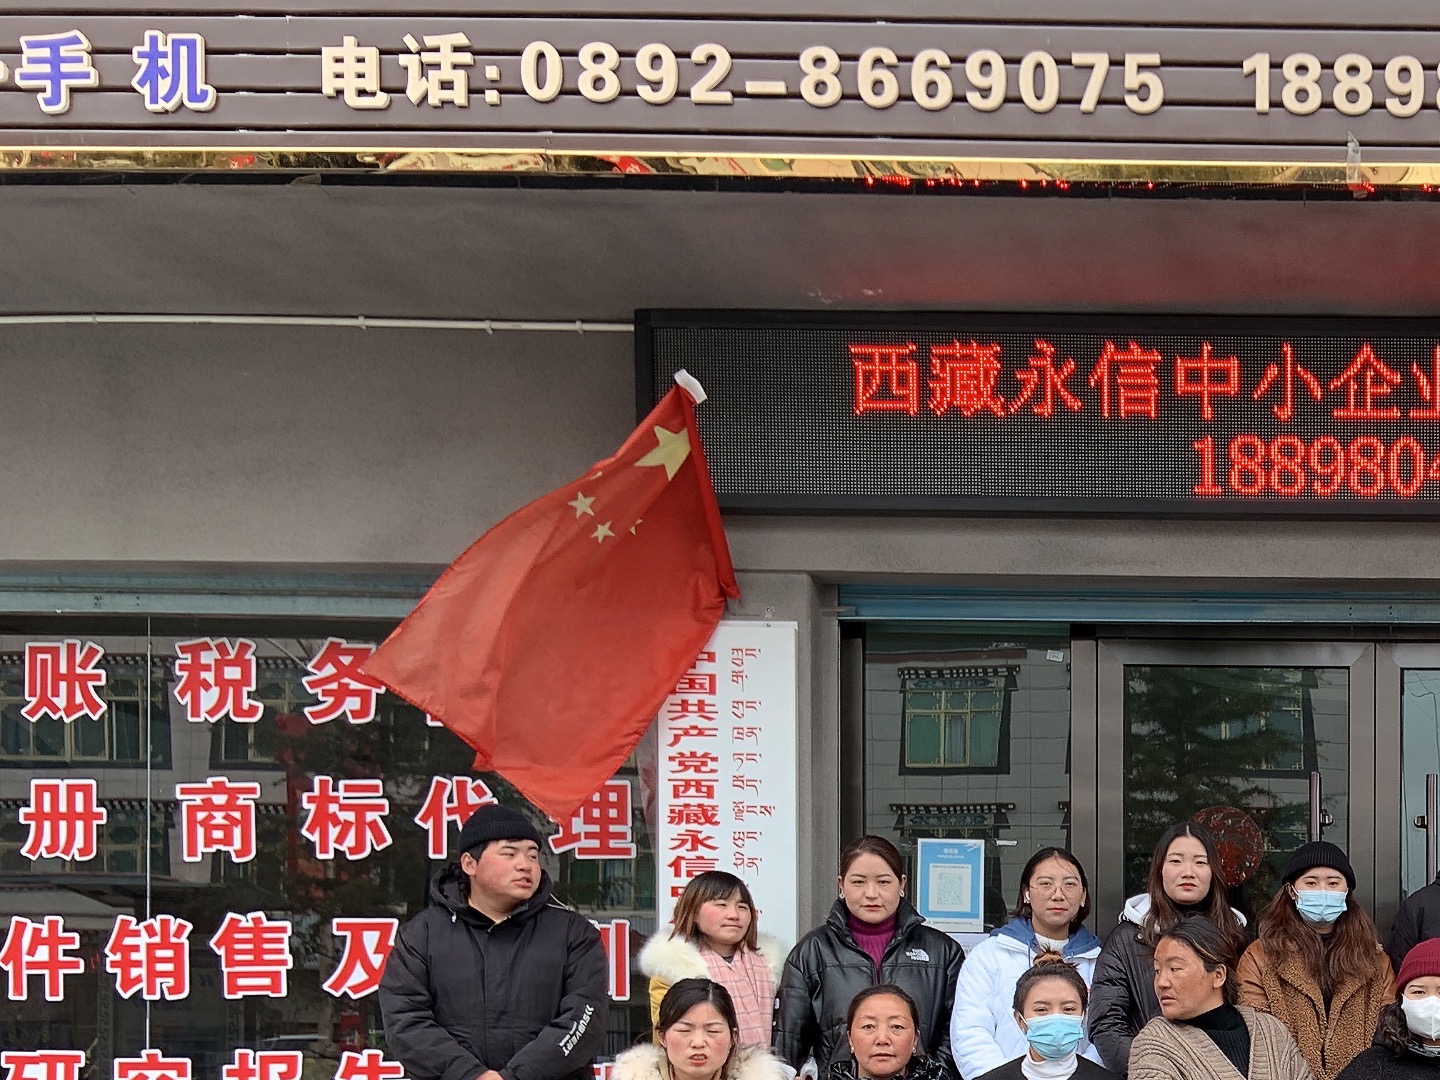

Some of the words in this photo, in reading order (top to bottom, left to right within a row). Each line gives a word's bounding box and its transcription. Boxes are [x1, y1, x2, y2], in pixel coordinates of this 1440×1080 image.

[667, 651, 721, 898] 国共产党西藏永信
